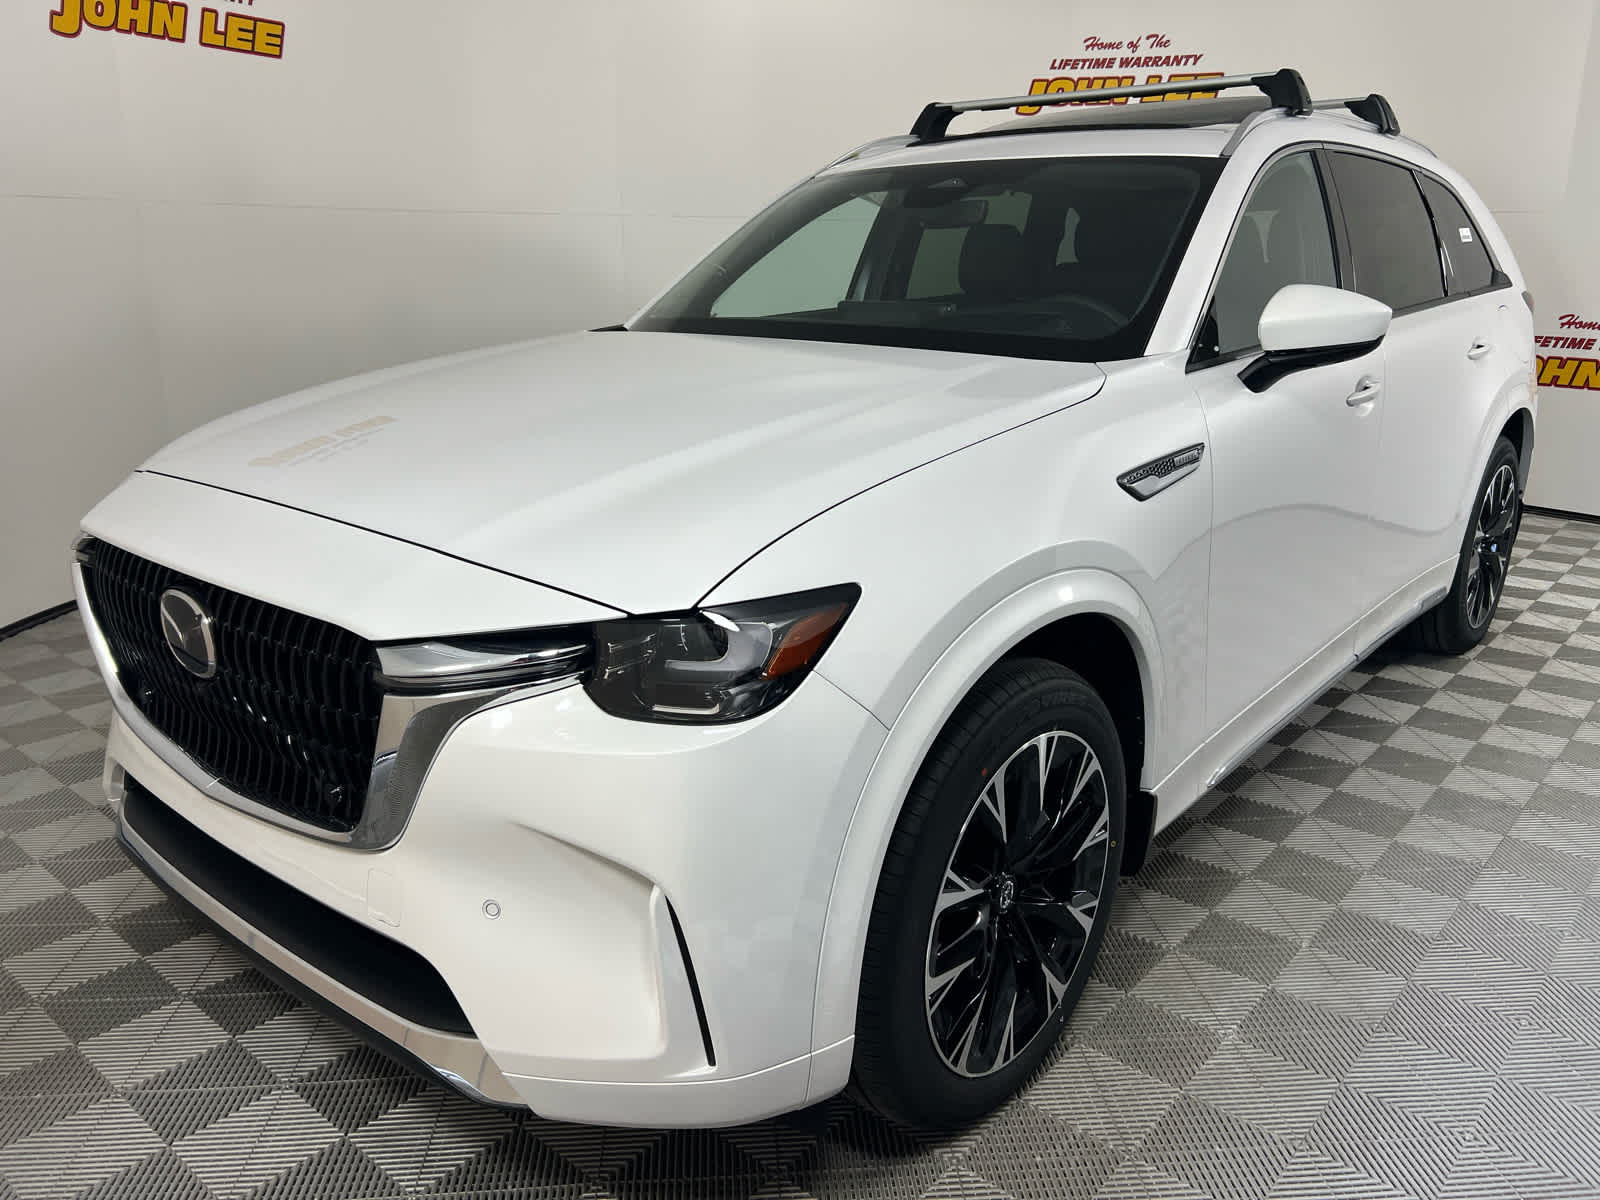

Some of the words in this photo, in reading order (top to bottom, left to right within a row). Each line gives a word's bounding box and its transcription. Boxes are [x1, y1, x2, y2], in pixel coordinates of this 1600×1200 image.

[50, 0, 188, 43] JOHN
[199, 7, 285, 59] LEE
[1083, 36, 1124, 51] Home
[1127, 37, 1142, 53] of
[1146, 34, 1171, 49] The
[1049, 57, 1117, 71] LIFETIME
[1118, 53, 1204, 69] WARRANTY
[1534, 335, 1598, 350] FETIME
